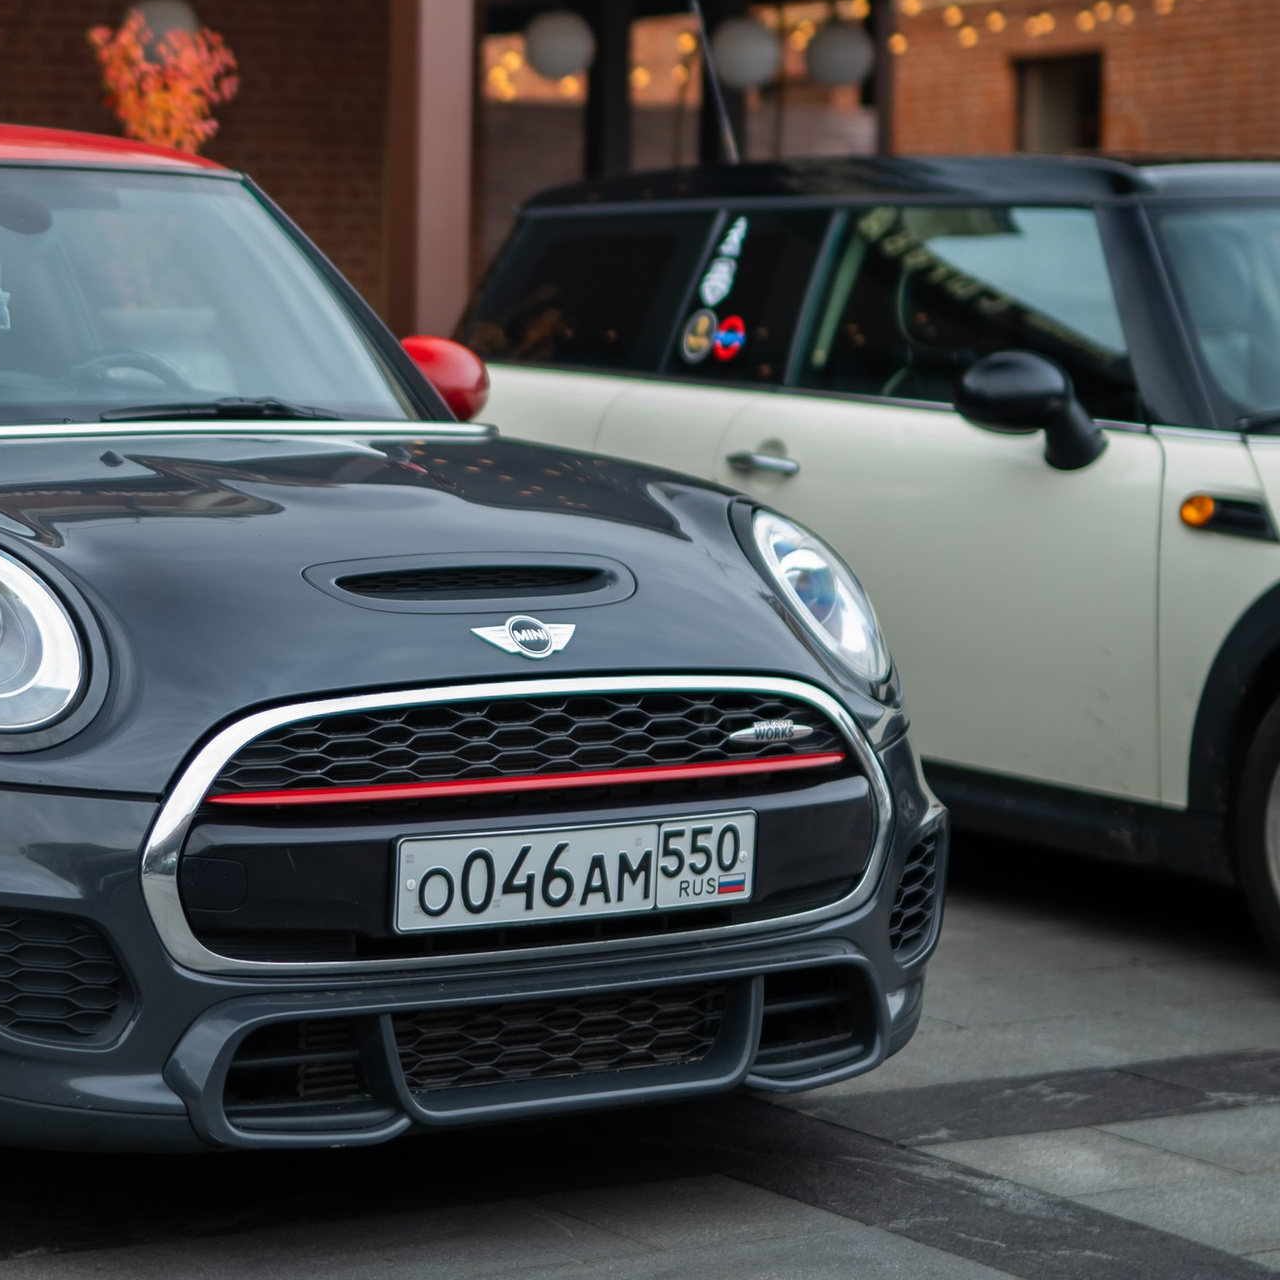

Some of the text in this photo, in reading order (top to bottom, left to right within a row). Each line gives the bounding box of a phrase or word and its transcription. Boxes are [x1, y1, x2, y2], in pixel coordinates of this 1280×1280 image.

[513, 627, 549, 642] MINI
[754, 725, 795, 741] WORKS
[660, 822, 741, 879] 550
[678, 877, 716, 898] RUS
